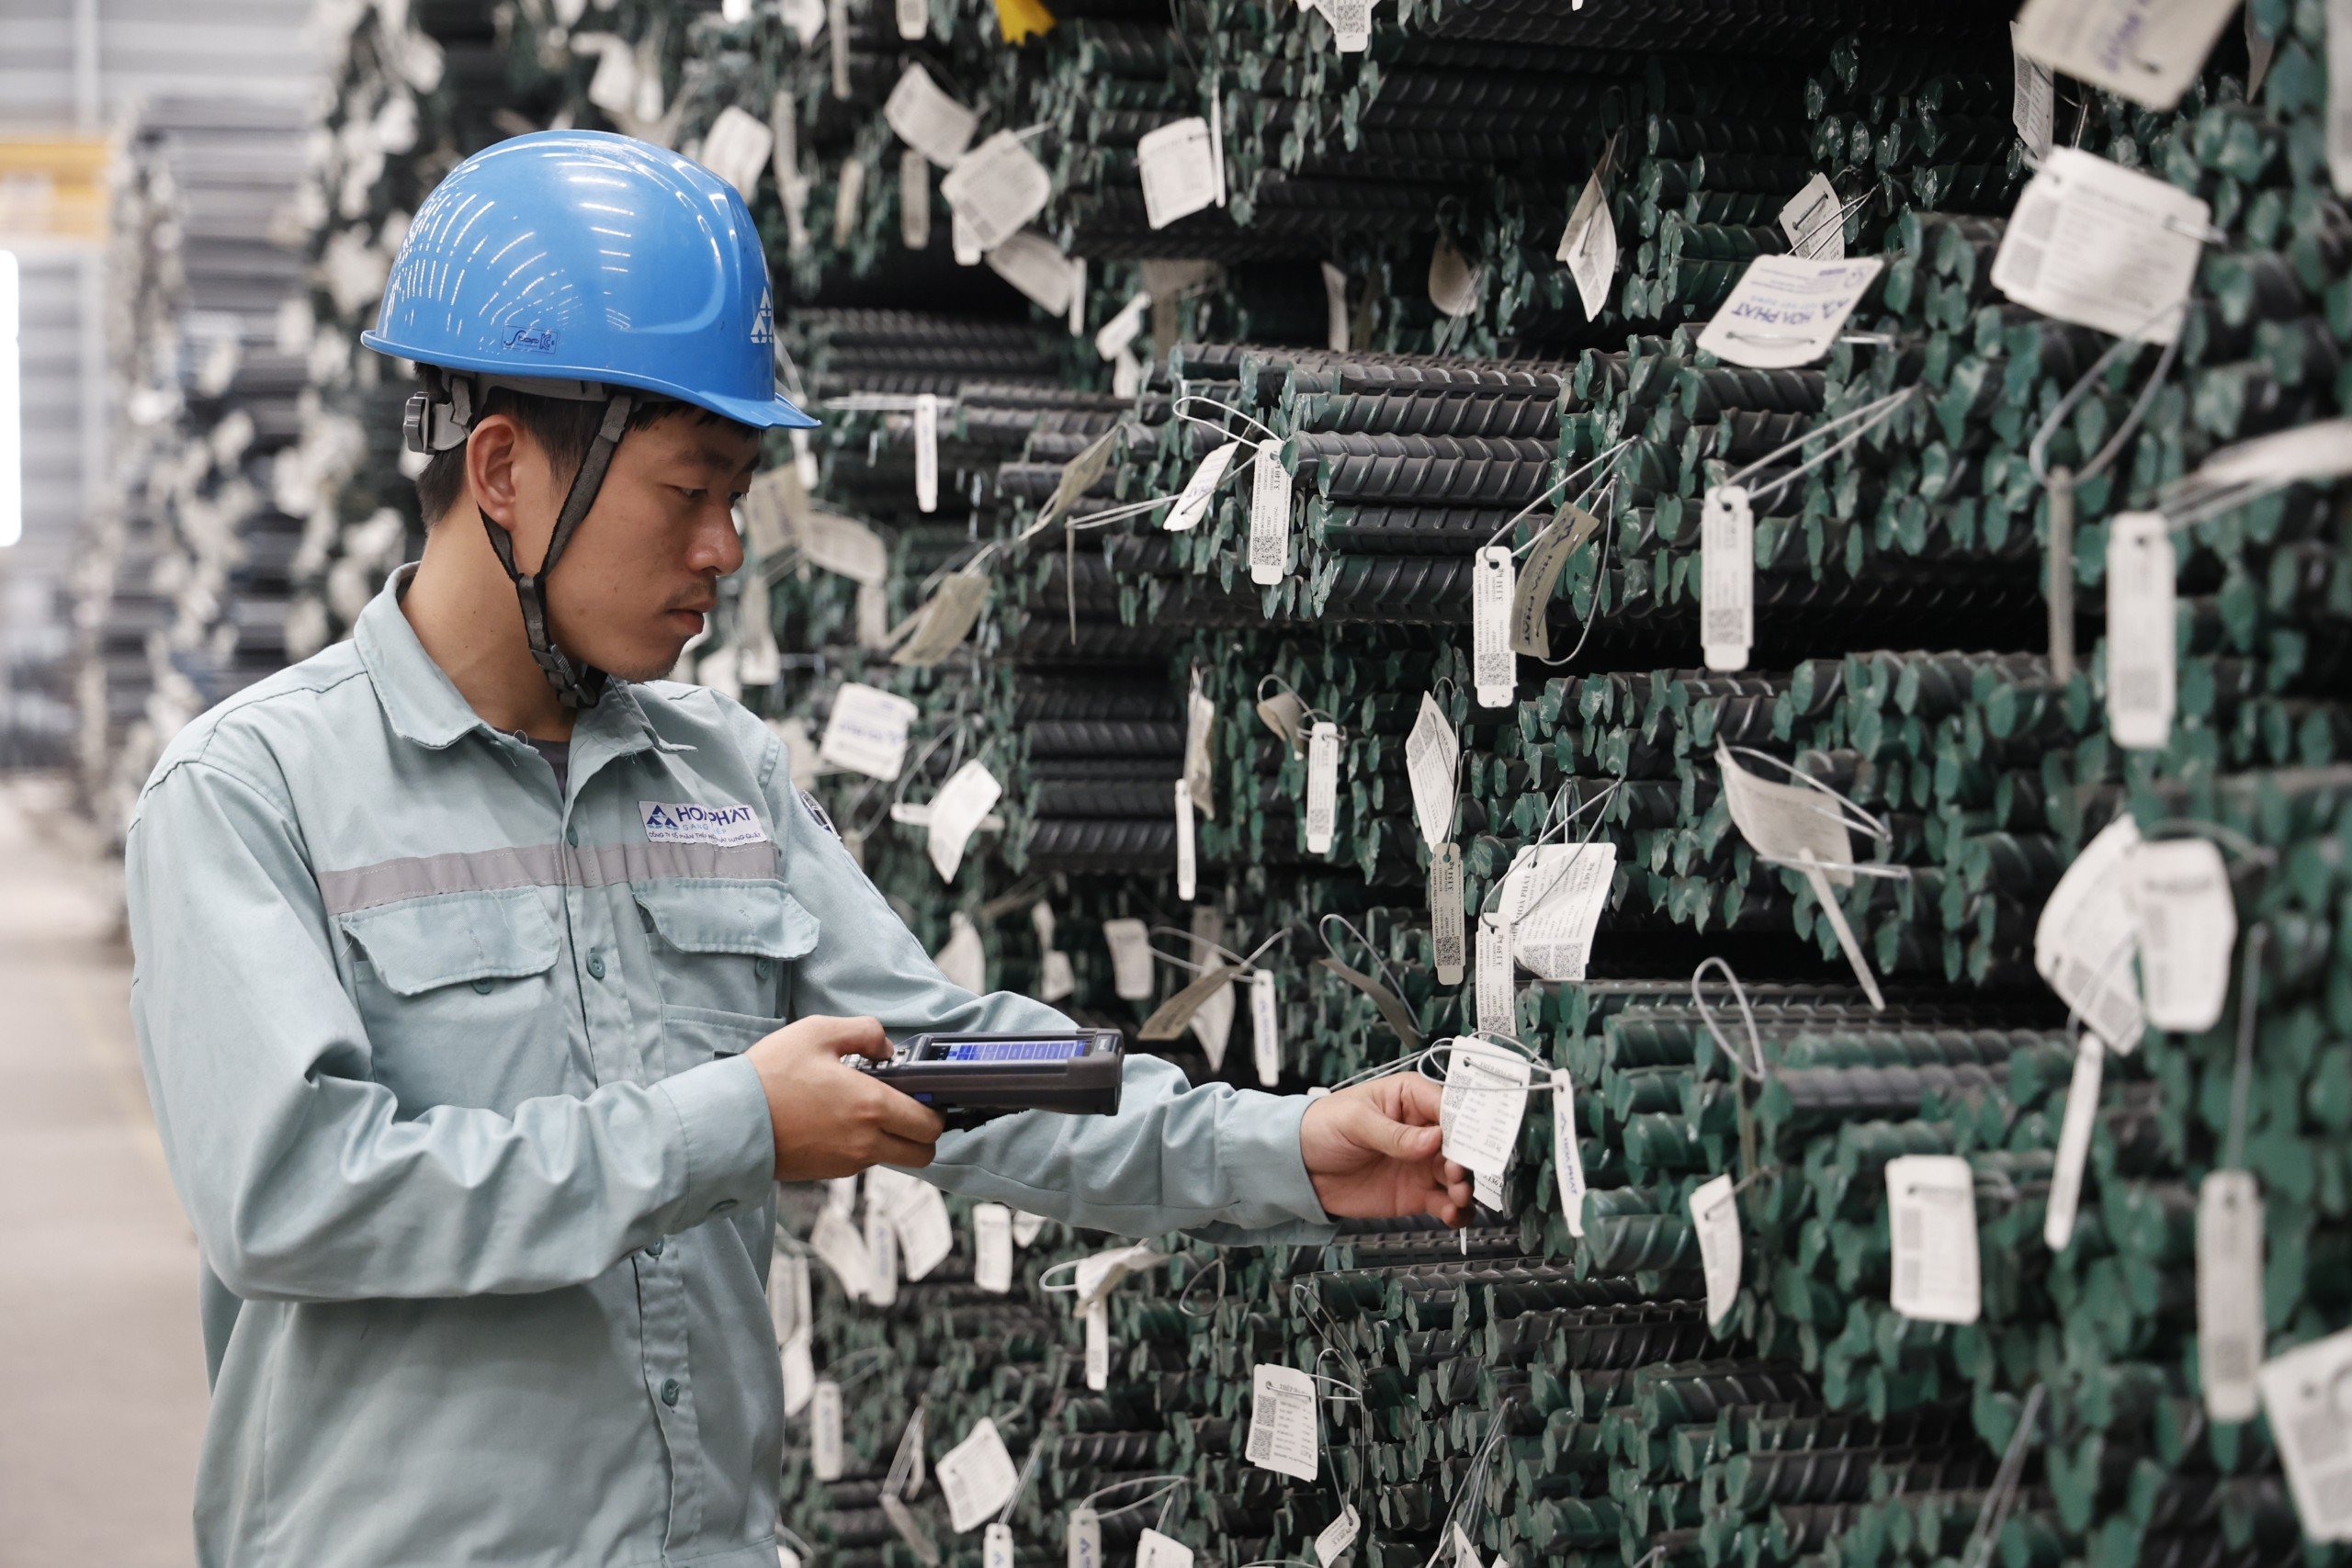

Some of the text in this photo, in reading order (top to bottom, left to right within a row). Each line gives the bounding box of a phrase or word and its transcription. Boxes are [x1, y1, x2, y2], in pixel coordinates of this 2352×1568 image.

[1496, 568, 1503, 577] kg
[1448, 862, 1454, 870] kg
[1496, 933, 1503, 942] kg
